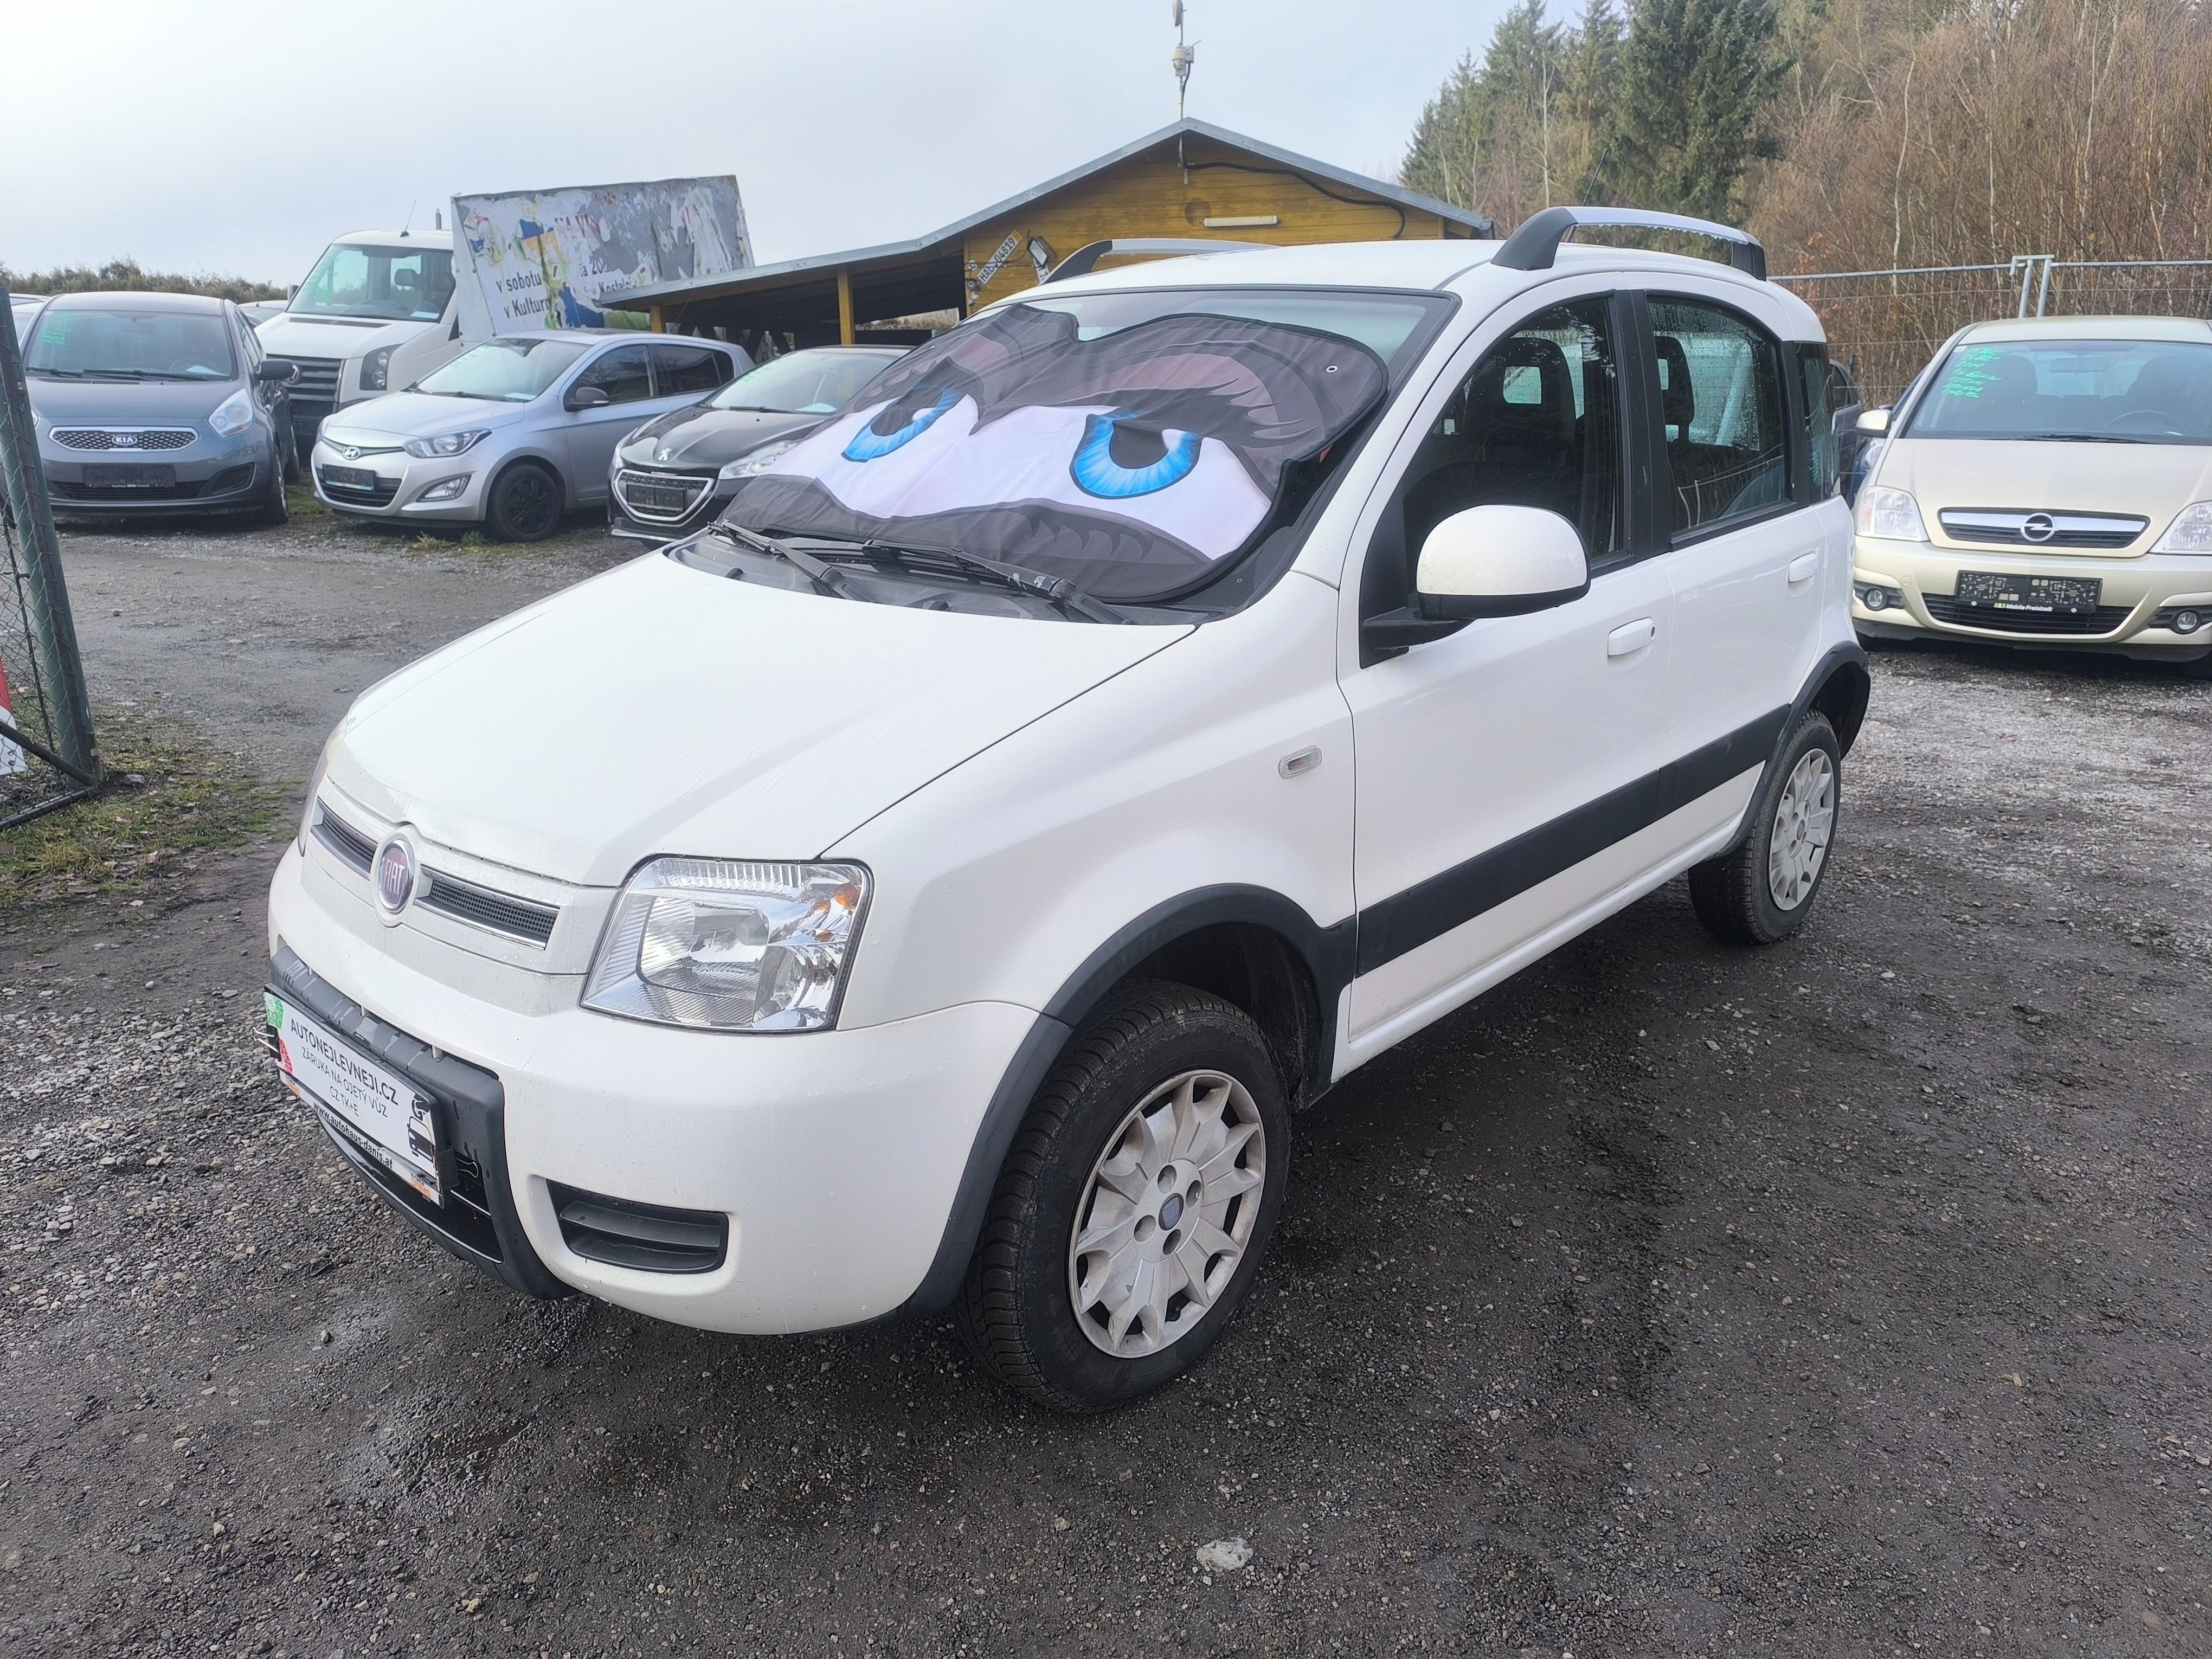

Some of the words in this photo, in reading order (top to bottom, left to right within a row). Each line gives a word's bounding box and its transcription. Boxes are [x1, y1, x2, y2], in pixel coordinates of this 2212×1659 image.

[994, 237, 1015, 263] 04819
[496, 280, 503, 293] v
[506, 270, 542, 292] sobotu
[503, 306, 510, 319] v
[383, 858, 406, 896] FIAT
[291, 1018, 398, 1106] AUTONEJLEVNEJI.CZ
[302, 1046, 330, 1078] ZÁRUKA
[331, 1069, 342, 1086] NA
[343, 1078, 367, 1104] OJETÝ
[369, 1096, 388, 1118] VŮZ
[330, 1086, 340, 1102] CZ
[340, 1093, 359, 1117] TK+E
[313, 1101, 393, 1169] www.autohaus-danis.at
